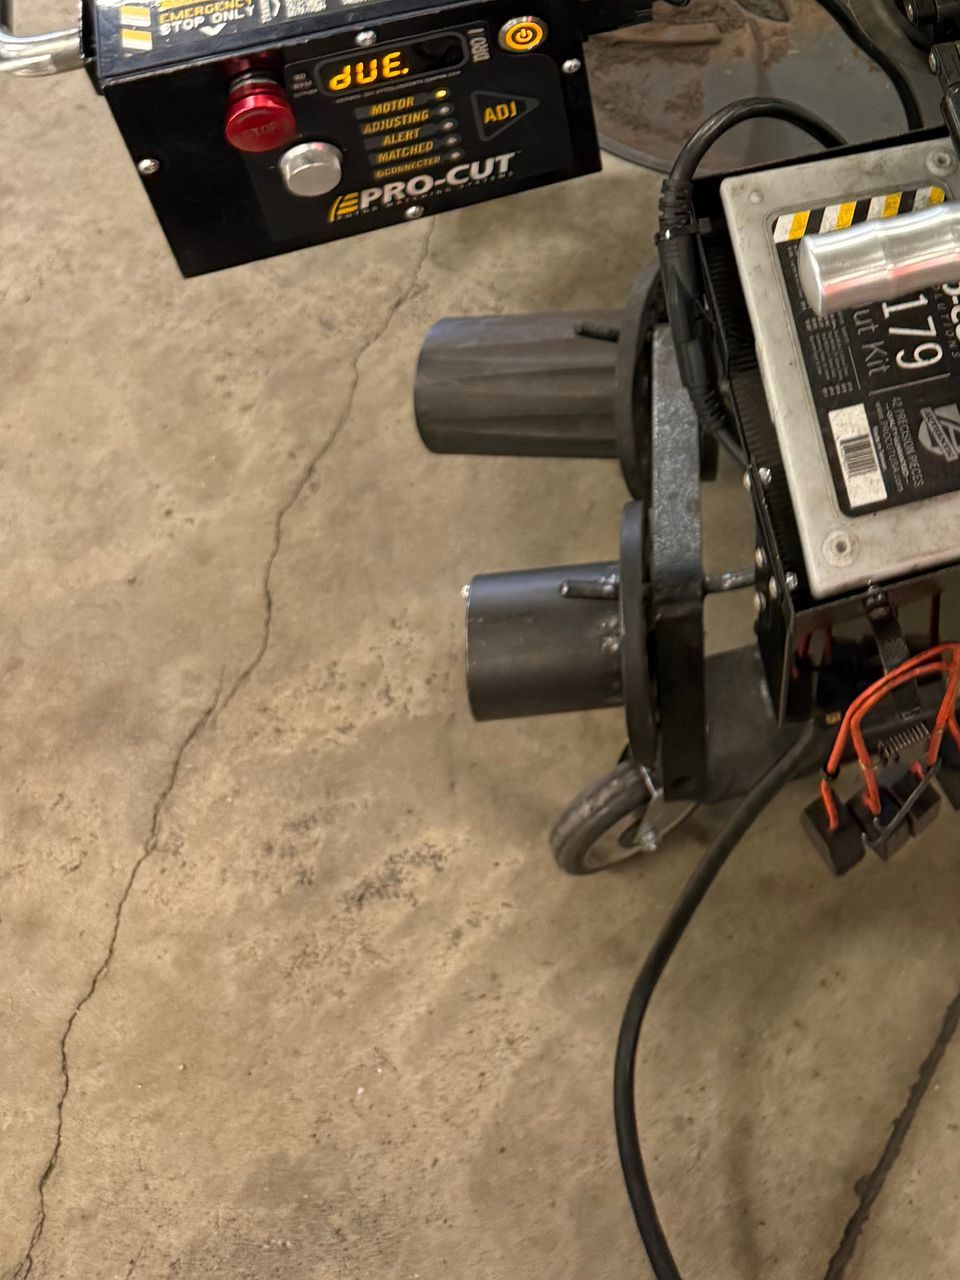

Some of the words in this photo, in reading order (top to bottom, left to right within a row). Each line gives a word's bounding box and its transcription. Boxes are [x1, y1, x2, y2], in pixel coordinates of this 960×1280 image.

[159, 17, 205, 37] STOP
[213, 4, 255, 24] ONLY
[369, 96, 415, 116] MOTOR
[484, 101, 518, 124] ADJ
[363, 110, 429, 134] ADJUSTING
[382, 128, 421, 146] ALERT
[377, 142, 433, 164] MATCHED
[361, 151, 516, 210] PRO-CUT
[861, 340, 890, 377] Kit
[894, 409, 915, 457] PRECISION
[907, 454, 924, 488] PIECES
